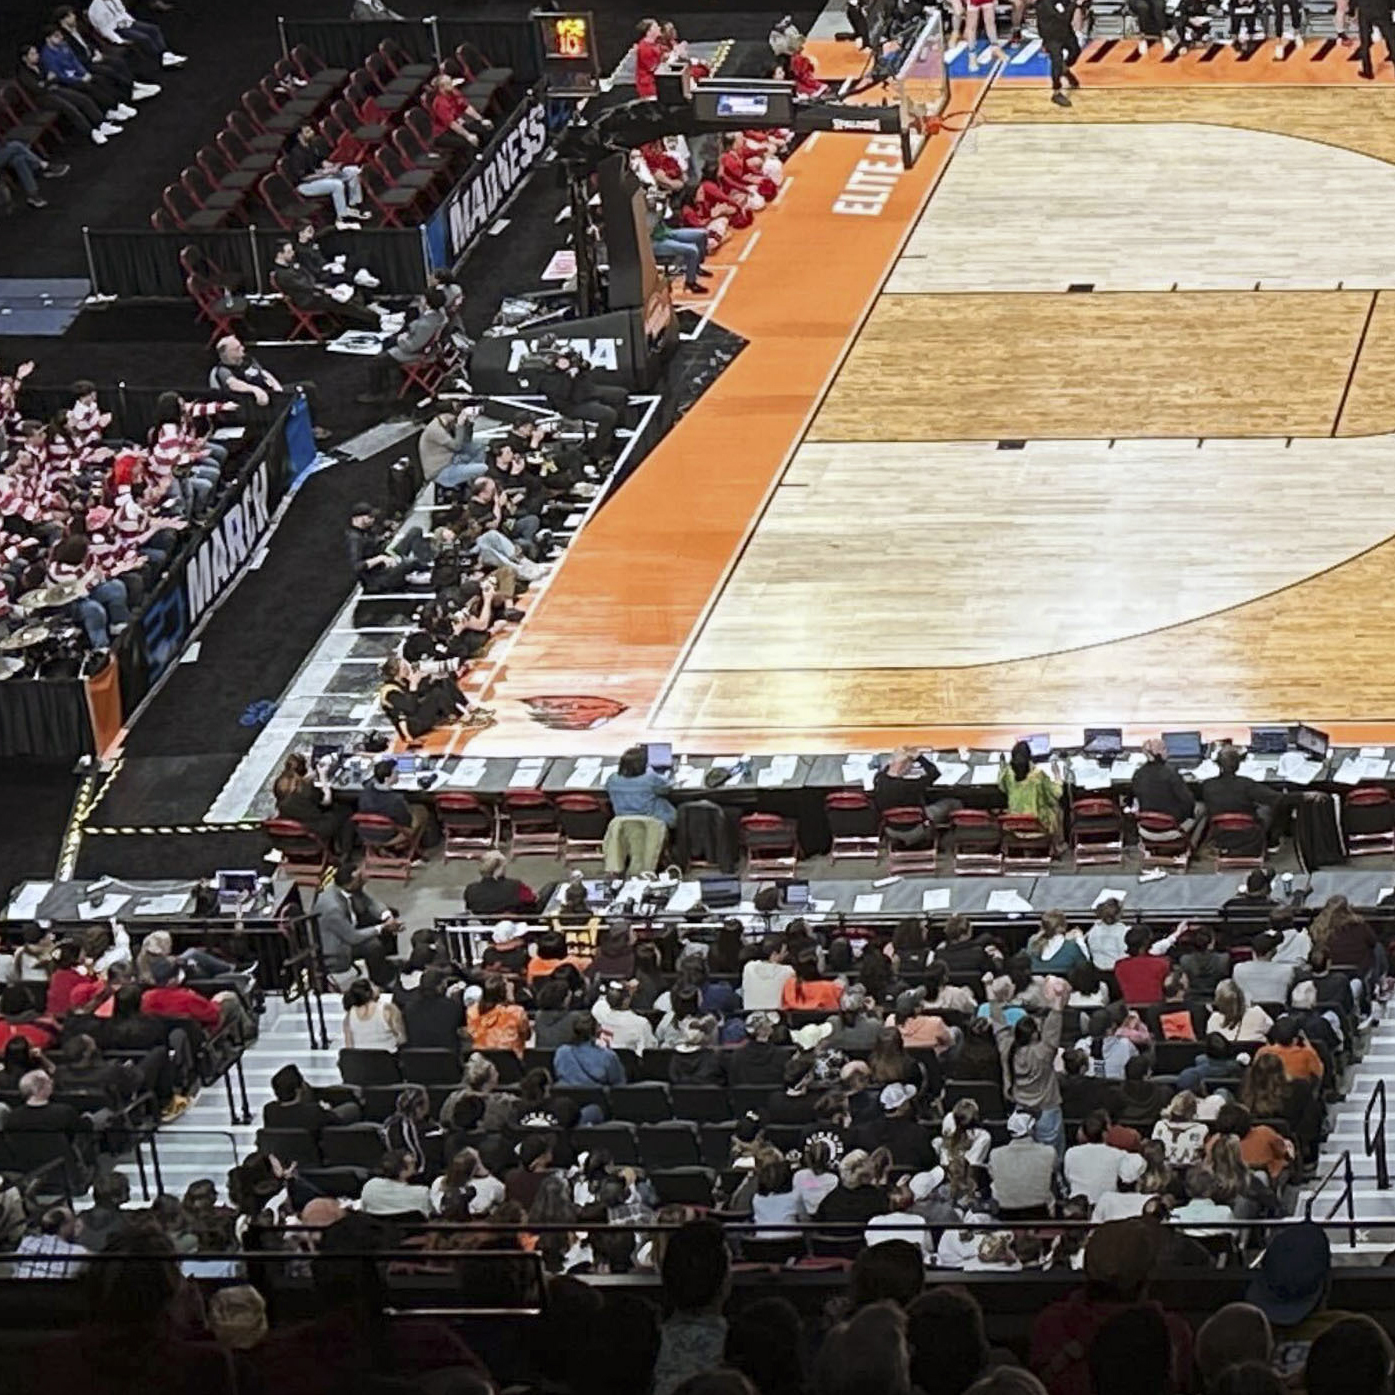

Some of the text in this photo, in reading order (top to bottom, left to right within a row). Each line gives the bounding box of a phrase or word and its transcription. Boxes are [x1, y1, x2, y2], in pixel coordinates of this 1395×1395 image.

[450, 102, 546, 256] MADNESS
[831, 158, 905, 217] ELITE
[186, 461, 270, 624] MARCH
